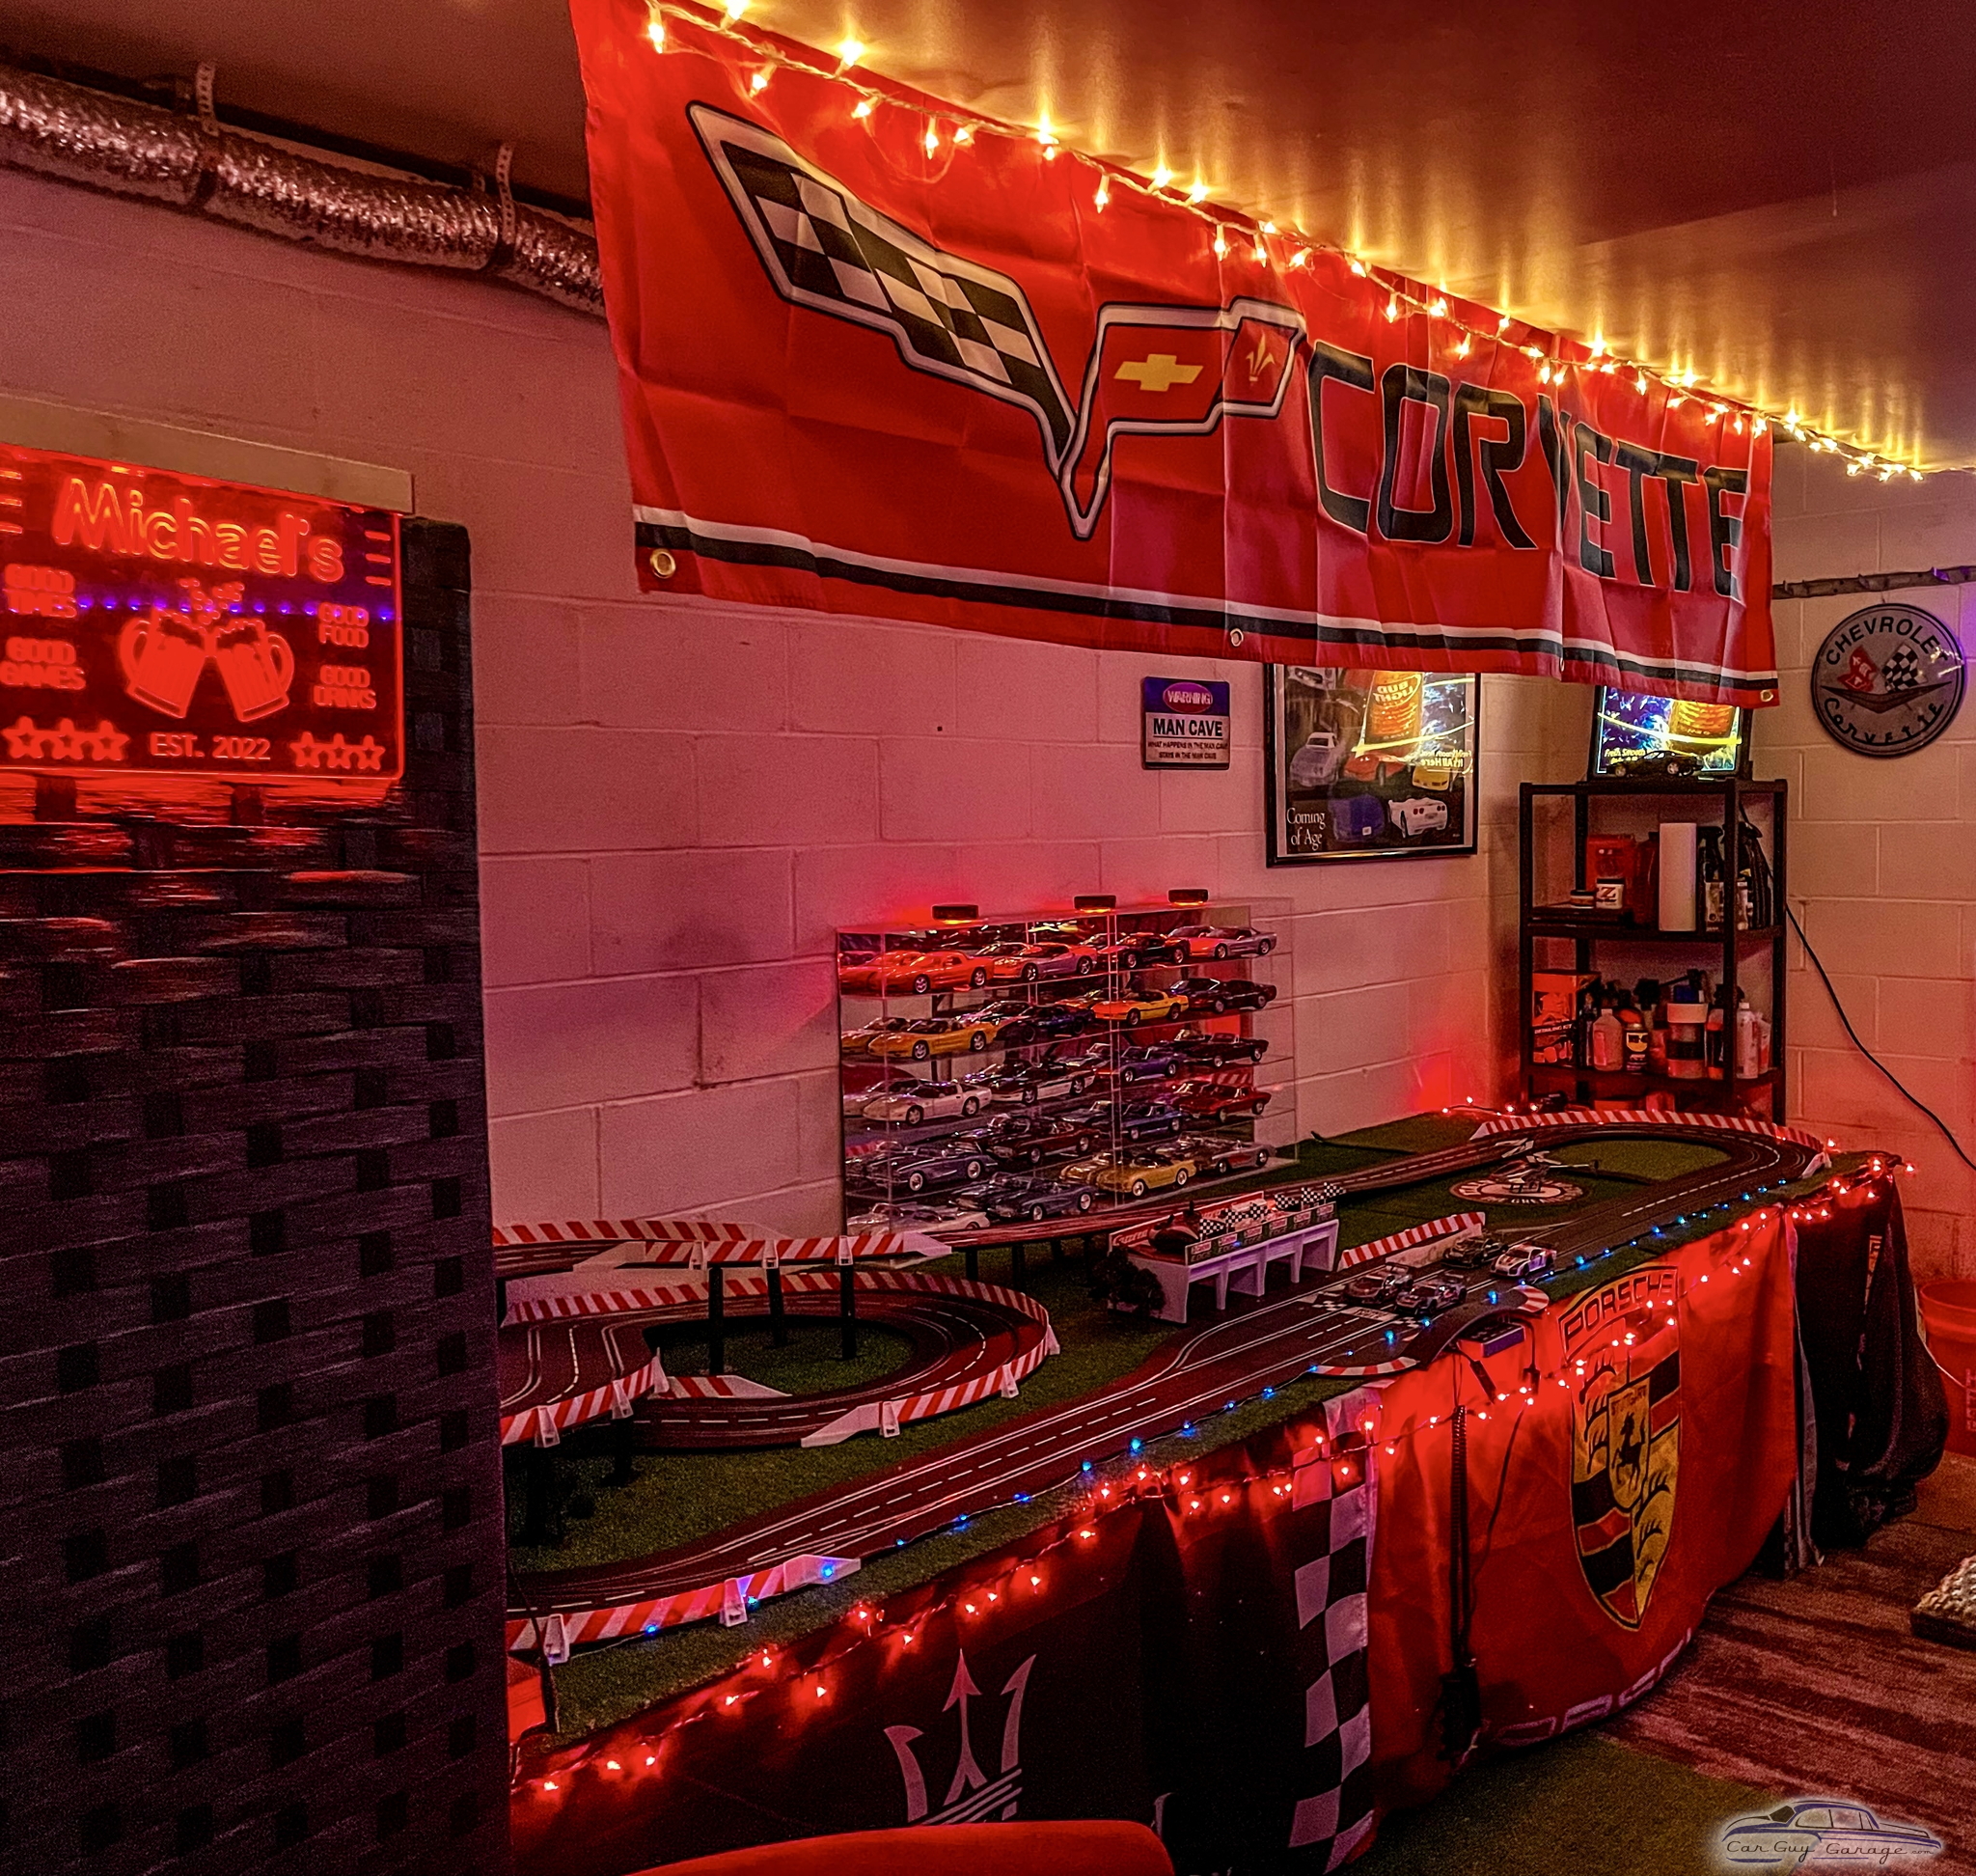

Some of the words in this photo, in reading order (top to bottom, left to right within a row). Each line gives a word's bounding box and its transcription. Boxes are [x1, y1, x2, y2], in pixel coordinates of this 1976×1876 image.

[1307, 340, 1749, 604] CORVETTE
[52, 478, 344, 583] Michael's
[5, 564, 75, 593] GOOD
[318, 601, 369, 626] GOOD
[318, 624, 369, 648] FOOD
[1826, 617, 1948, 665] CHEVROLET
[6, 637, 76, 665] GOOD
[320, 665, 370, 687] GOOD
[1167, 690, 1211, 704] WARNING
[1153, 718, 1185, 735] MAN
[1189, 720, 1222, 736] CAVE
[150, 732, 206, 758] EST.
[212, 735, 270, 759] 2022
[1286, 807, 1326, 830] Coming
[1291, 826, 1303, 845] of
[1304, 828, 1323, 851] Age
[1564, 1273, 1675, 1350] PORSCHE
